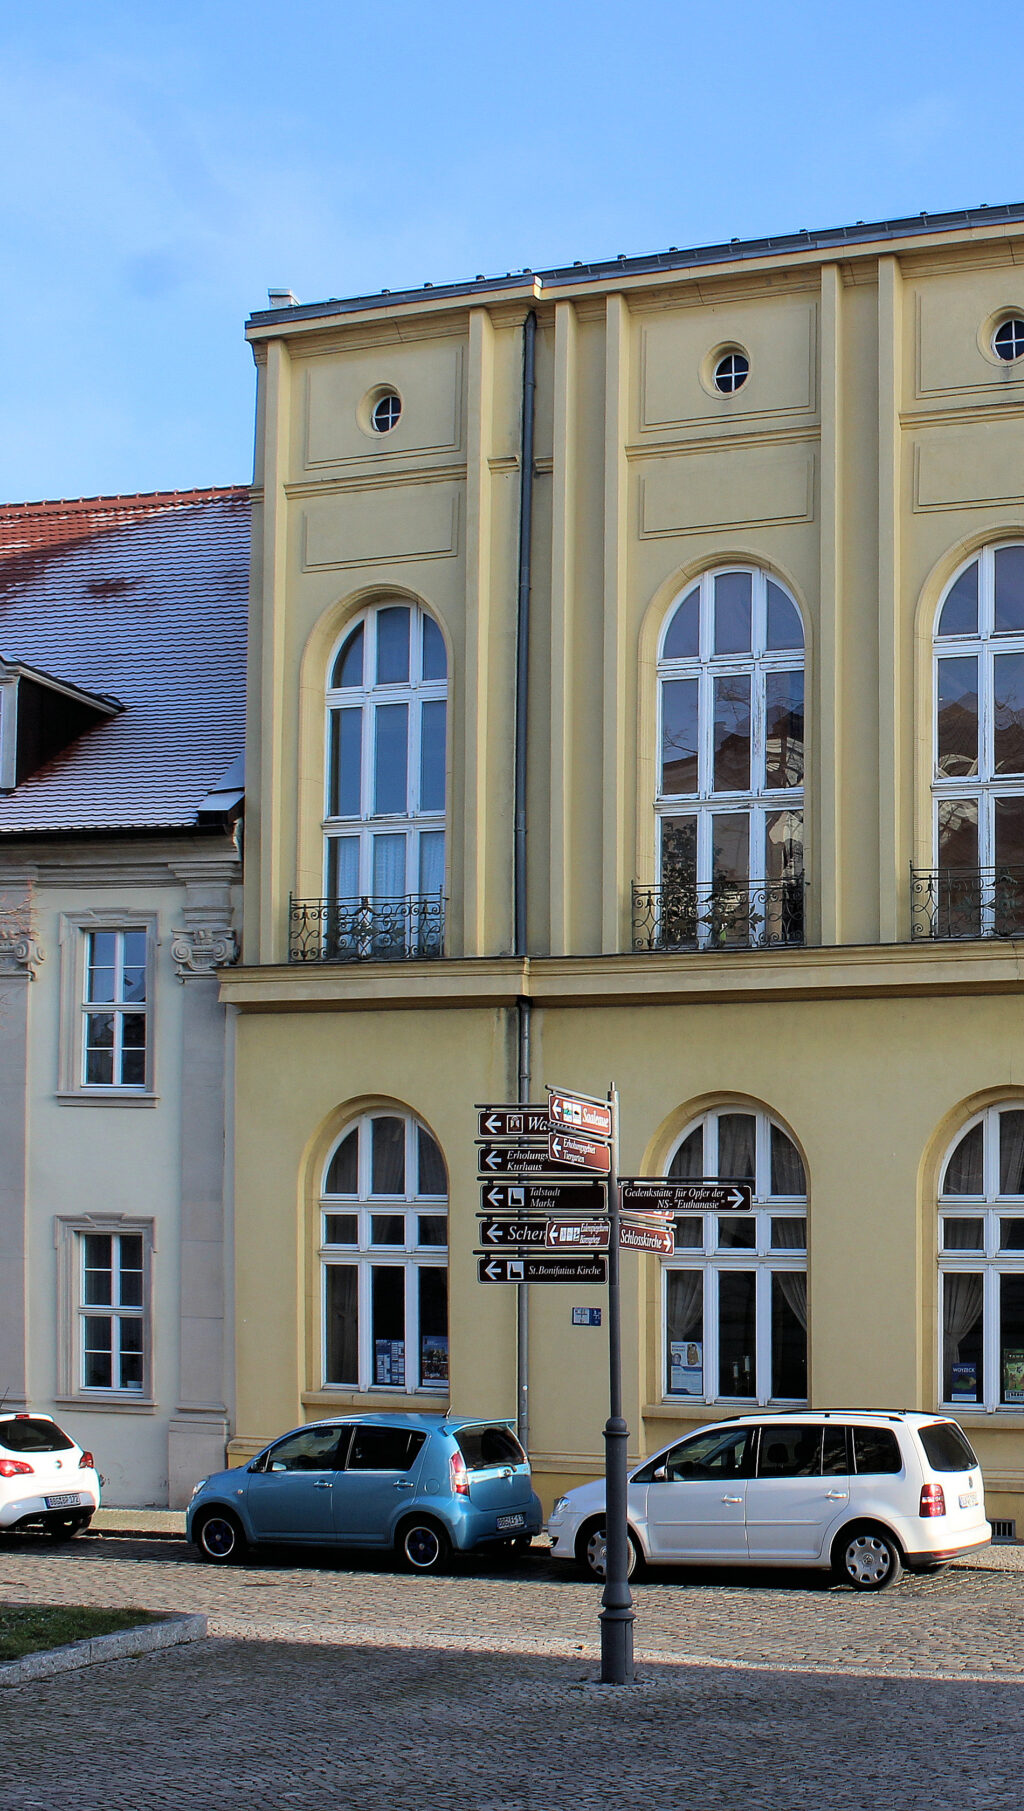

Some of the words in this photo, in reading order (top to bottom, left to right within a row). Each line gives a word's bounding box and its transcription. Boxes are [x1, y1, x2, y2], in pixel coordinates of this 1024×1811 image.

[506, 1150, 550, 1162] Erholungs
[506, 1161, 543, 1171] Kurhaus
[529, 1186, 561, 1197] Talstadt
[624, 1187, 673, 1198] Gedenkstätte
[675, 1187, 687, 1200] für
[688, 1187, 710, 1200] Opfer
[711, 1187, 725, 1198] der
[530, 1198, 556, 1208] Markt
[620, 1228, 663, 1249] Schlosskirche
[576, 1265, 602, 1275] Kirche
